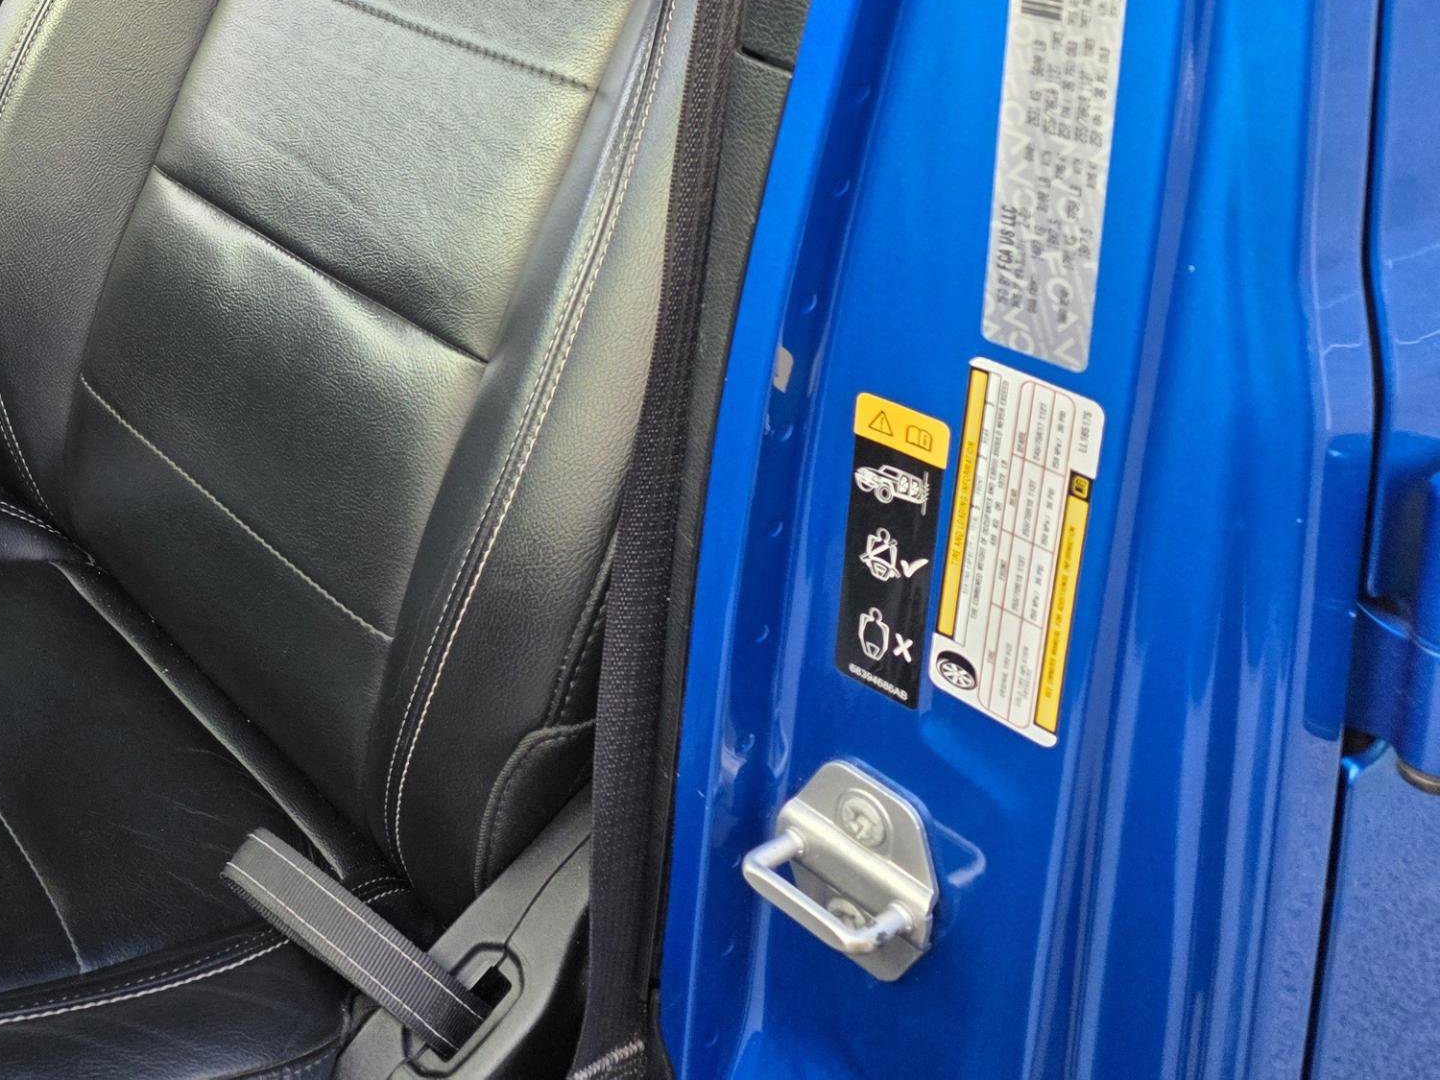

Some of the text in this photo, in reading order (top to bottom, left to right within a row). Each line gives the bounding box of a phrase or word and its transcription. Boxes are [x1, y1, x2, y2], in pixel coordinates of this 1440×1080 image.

[1000, 203, 1017, 226] LLC
[999, 228, 1014, 246] US
[996, 247, 1013, 271] FCA
[953, 530, 963, 548] AND
